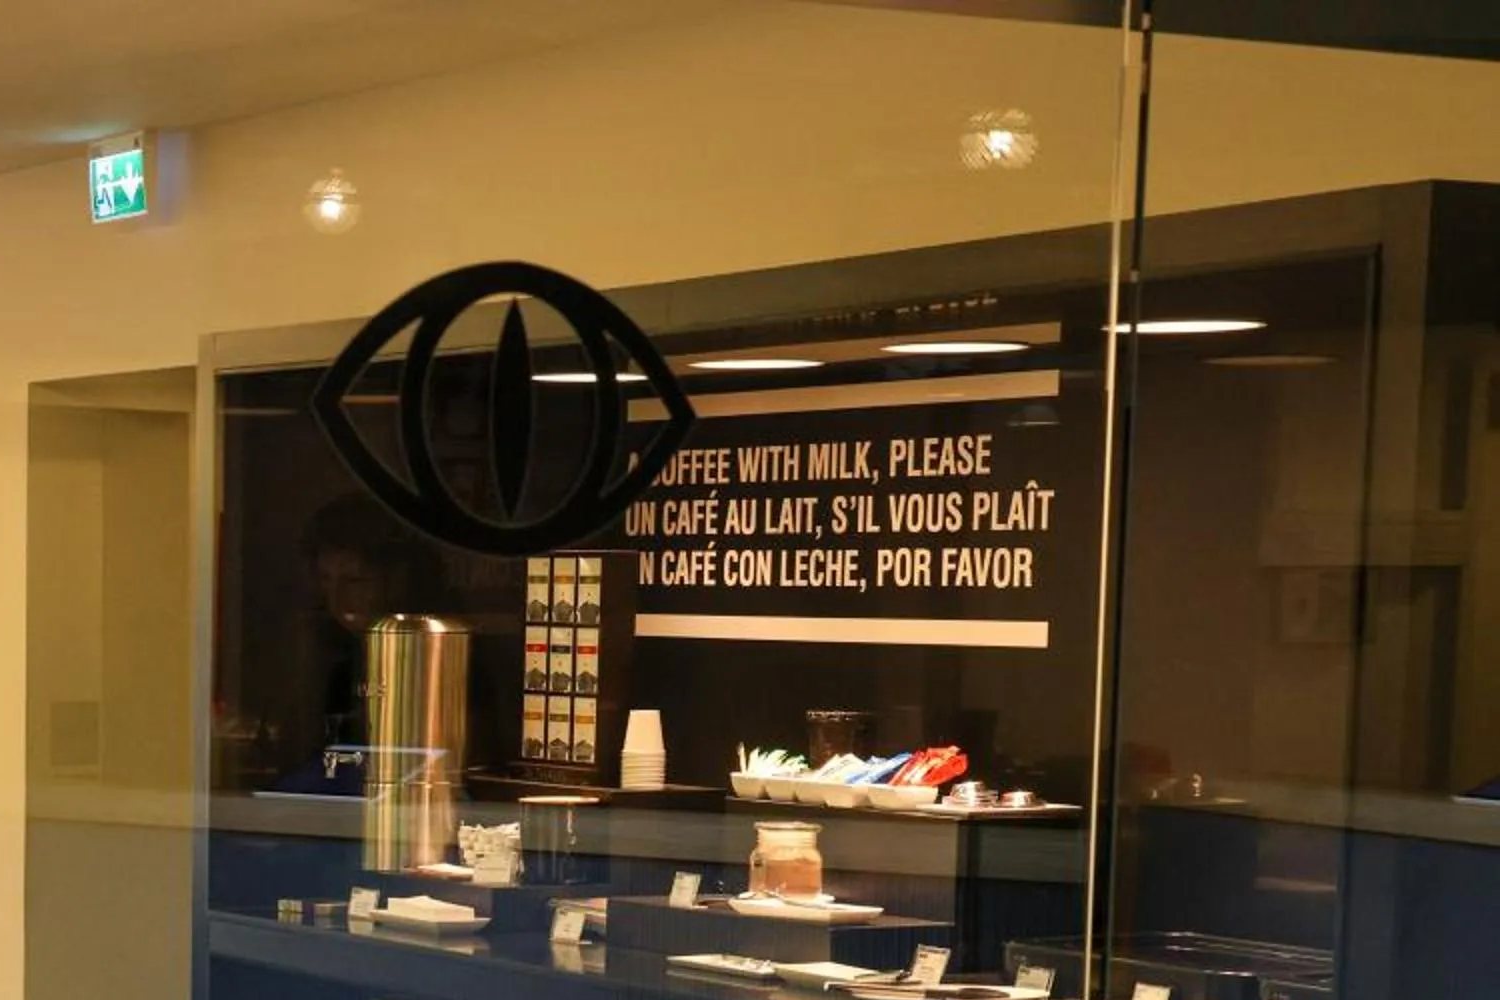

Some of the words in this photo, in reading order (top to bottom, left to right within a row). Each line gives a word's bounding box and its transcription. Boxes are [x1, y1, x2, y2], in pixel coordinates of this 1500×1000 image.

[652, 448, 731, 487] OFFEE
[738, 444, 800, 483] WITH
[807, 440, 879, 485] MILK,
[889, 434, 993, 477] PLEASE
[625, 501, 656, 536] UN
[662, 489, 720, 537] CAFÉ
[724, 498, 757, 535] AU
[765, 496, 824, 541] LAIT,
[889, 491, 964, 534] VOUS
[972, 479, 1056, 532] PLAÎT
[638, 550, 655, 586] N
[661, 540, 717, 588] CAFÉ
[723, 549, 773, 588] CON
[780, 548, 867, 593] LECHE,
[876, 547, 933, 588] POR
[940, 547, 1034, 589] FAVOR
